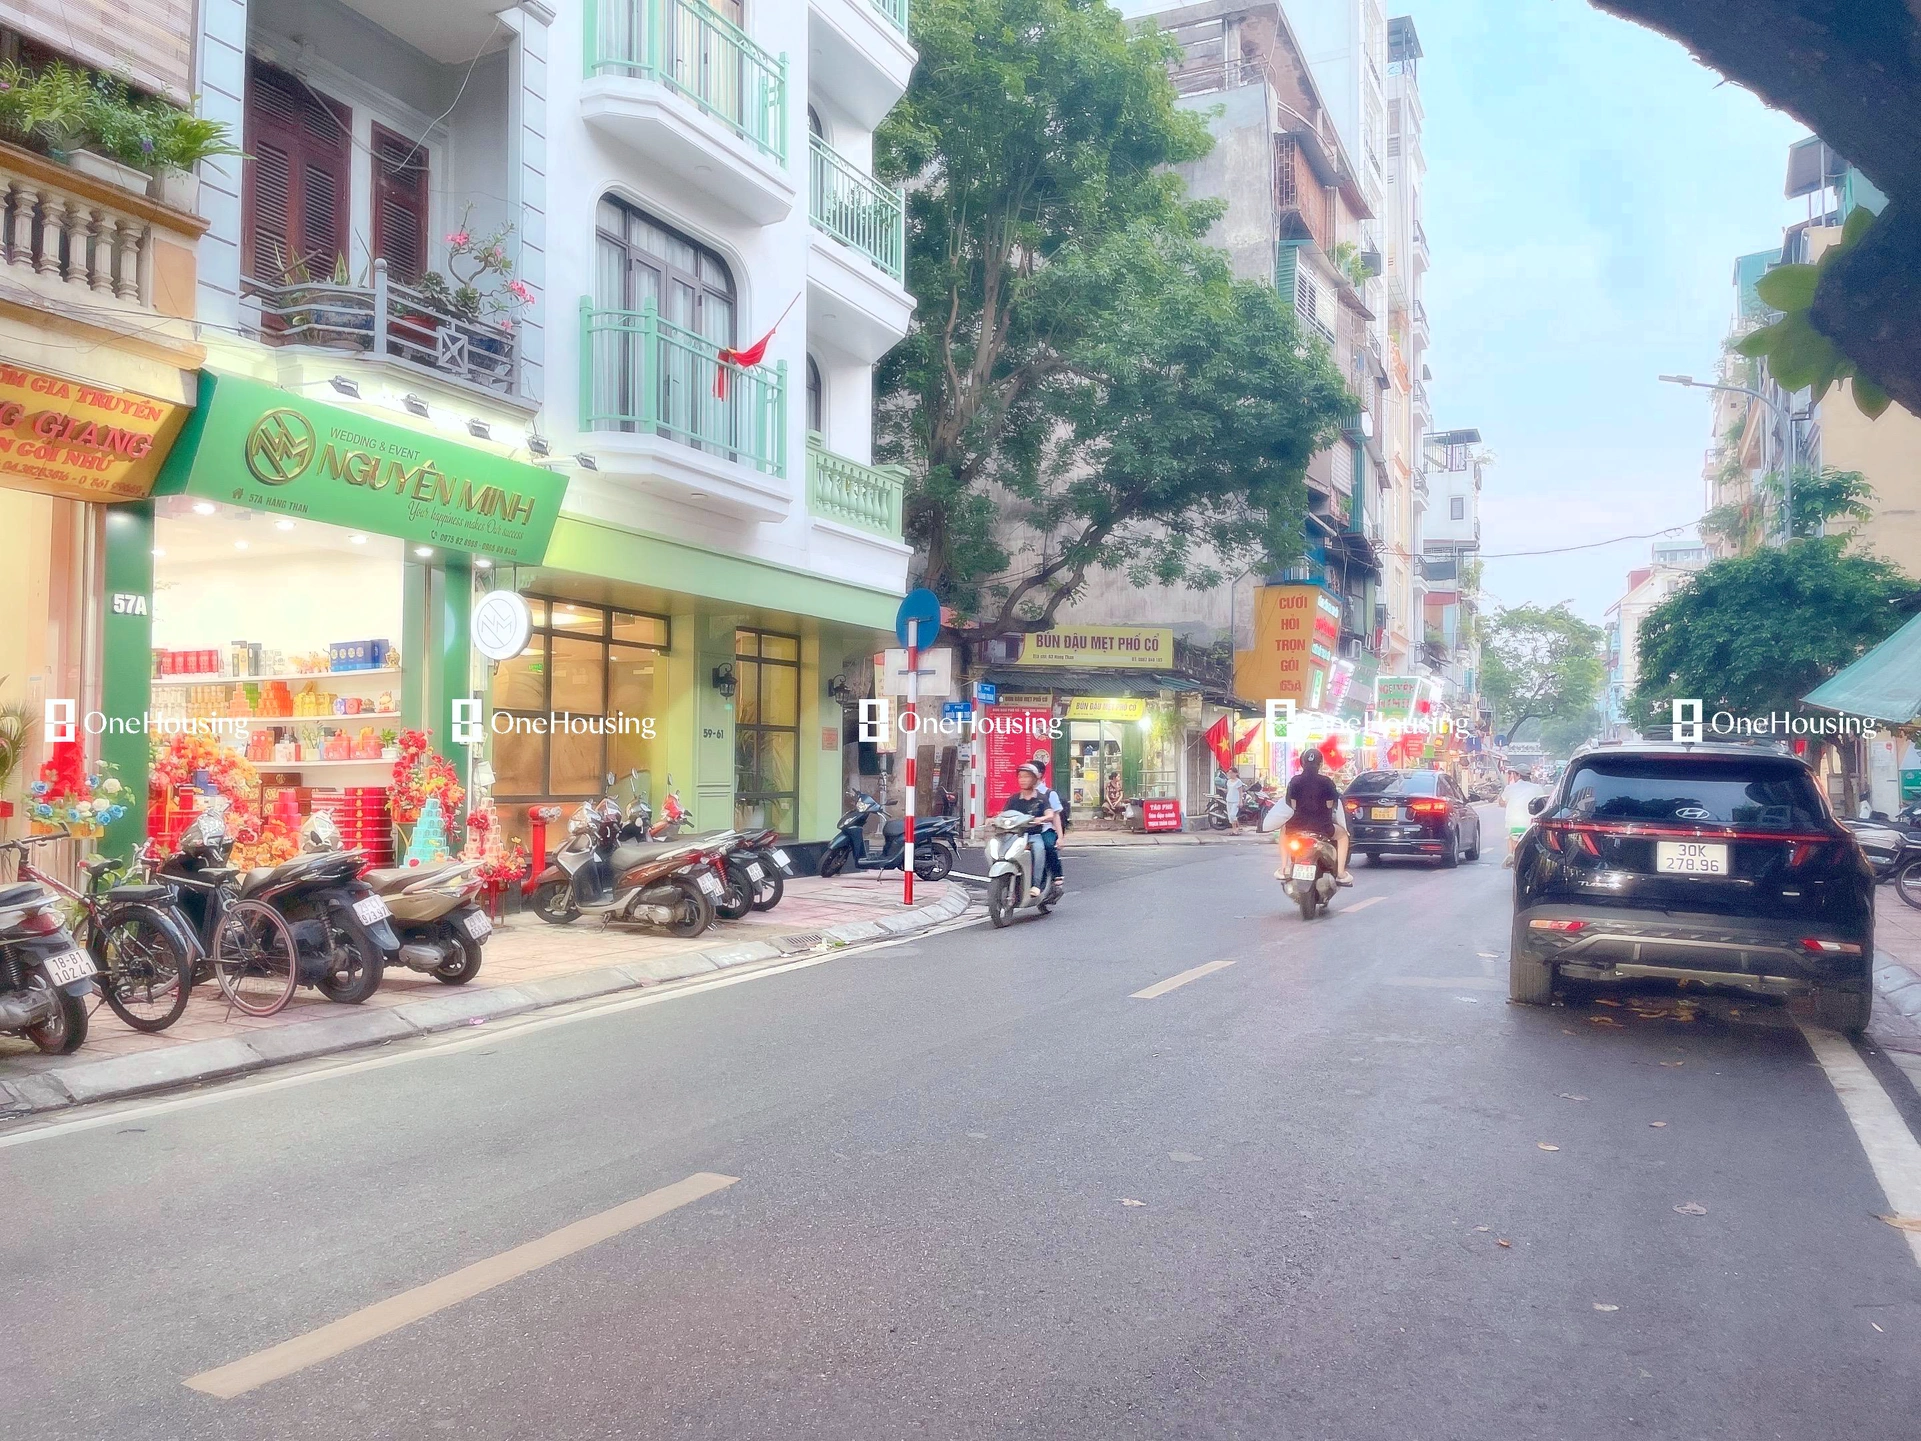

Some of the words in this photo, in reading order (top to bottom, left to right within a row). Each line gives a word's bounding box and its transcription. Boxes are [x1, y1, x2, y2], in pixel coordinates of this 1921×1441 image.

[31, 376, 70, 399] GIA
[34, 410, 153, 460] GIANG
[330, 427, 377, 449] WEDDING
[379, 442, 386, 451] &
[388, 444, 420, 461] EVENT
[317, 442, 457, 506] NGUYÊN
[457, 479, 536, 526] MINH
[249, 494, 263, 505] 57A
[289, 501, 309, 514] THAN
[408, 500, 428, 521] Your
[431, 506, 463, 528] happiness
[464, 517, 485, 532] makes
[501, 529, 525, 540] success
[113, 593, 147, 616] 57A
[1279, 593, 1307, 609] CƯỚI
[1281, 613, 1299, 630] HỎI
[1036, 632, 1060, 648] BÚN
[1064, 633, 1087, 652] ĐẬU
[1091, 636, 1114, 653] MẸT
[1118, 632, 1141, 650] PHỐ
[1144, 633, 1160, 651] CỔ
[1275, 639, 1306, 653] TRỌN
[1281, 657, 1299, 671] GÓI
[703, 728, 724, 739] 59-61
[1679, 844, 1706, 857] 30K
[1666, 858, 1719, 872] 278.96
[361, 906, 387, 924] 973.97
[53, 951, 83, 970] 18-B1
[55, 962, 94, 983] 102.41
